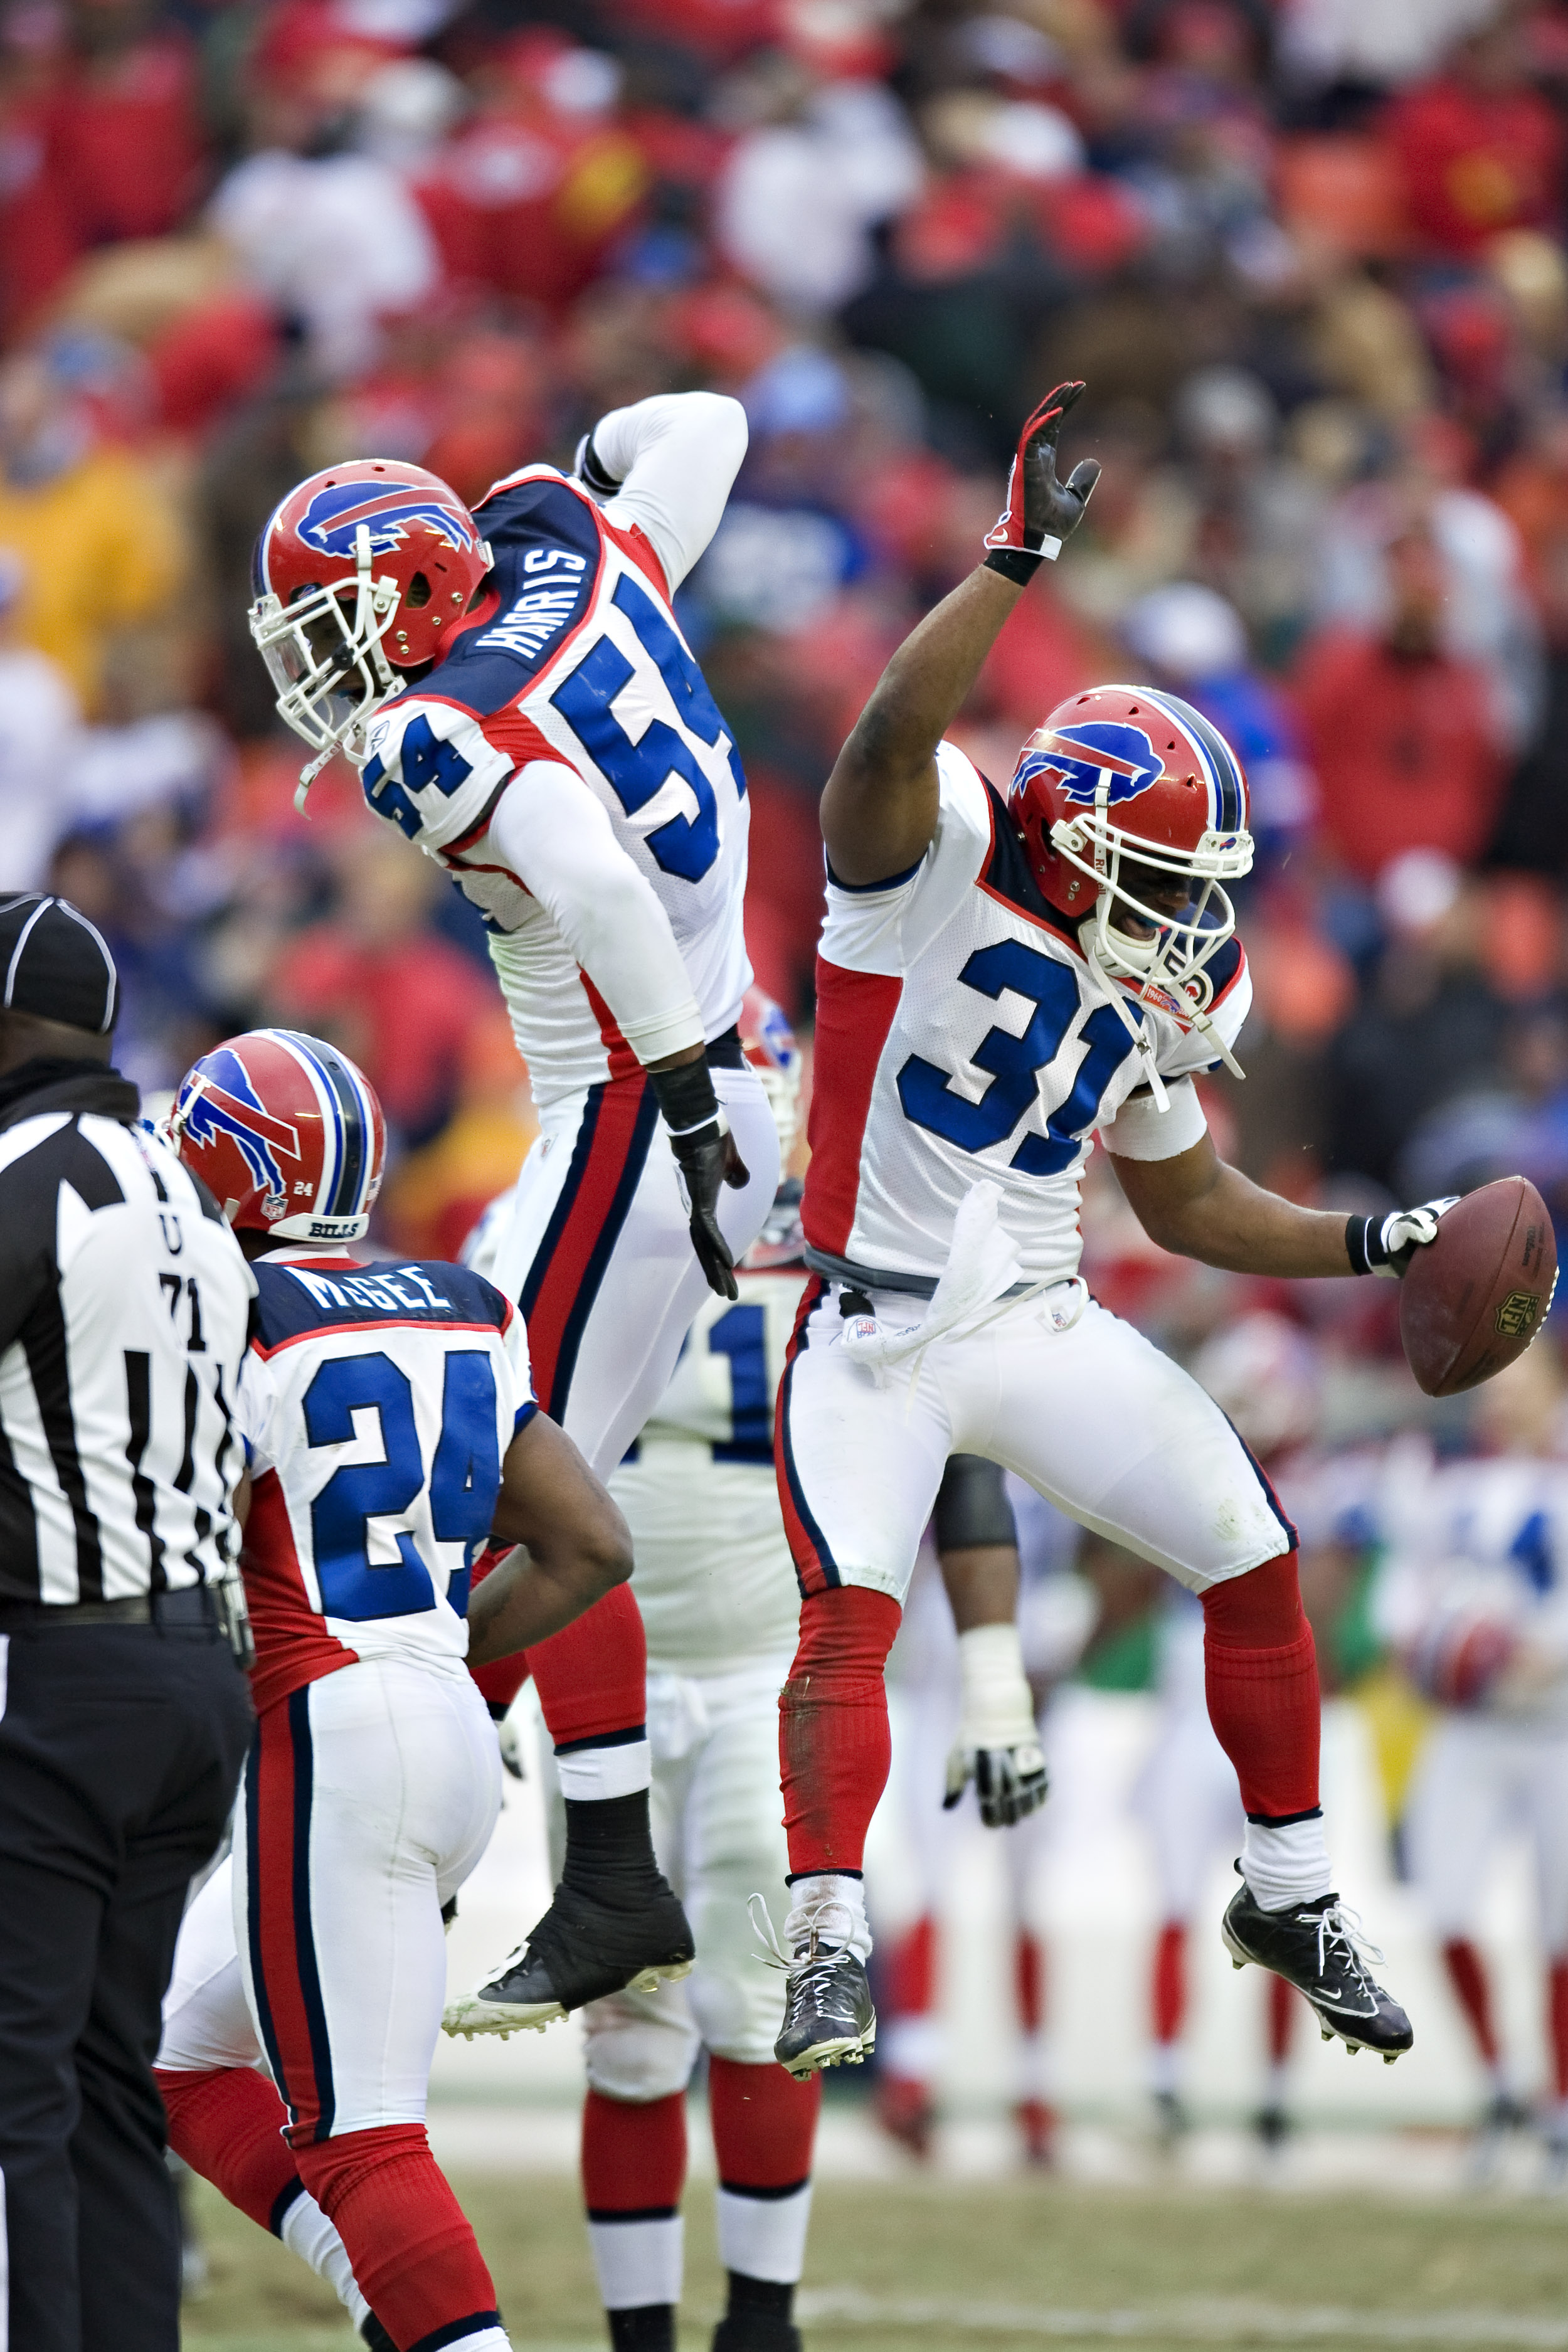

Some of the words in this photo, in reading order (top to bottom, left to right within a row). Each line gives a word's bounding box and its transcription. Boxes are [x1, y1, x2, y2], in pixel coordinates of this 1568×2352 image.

[475, 549, 587, 660] HARRIS
[358, 713, 474, 840] 54
[1095, 858, 1106, 895] Riell
[1147, 988, 1163, 1002] 1960
[896, 938, 1145, 1176] 31
[294, 1181, 314, 1197] 24
[158, 1214, 183, 1255] U
[308, 1222, 359, 1239] BILLS
[159, 1273, 206, 1352] 71
[1501, 1295, 1528, 1330] NFL
[668, 1303, 775, 1465] 1
[302, 1350, 501, 1622] 24
